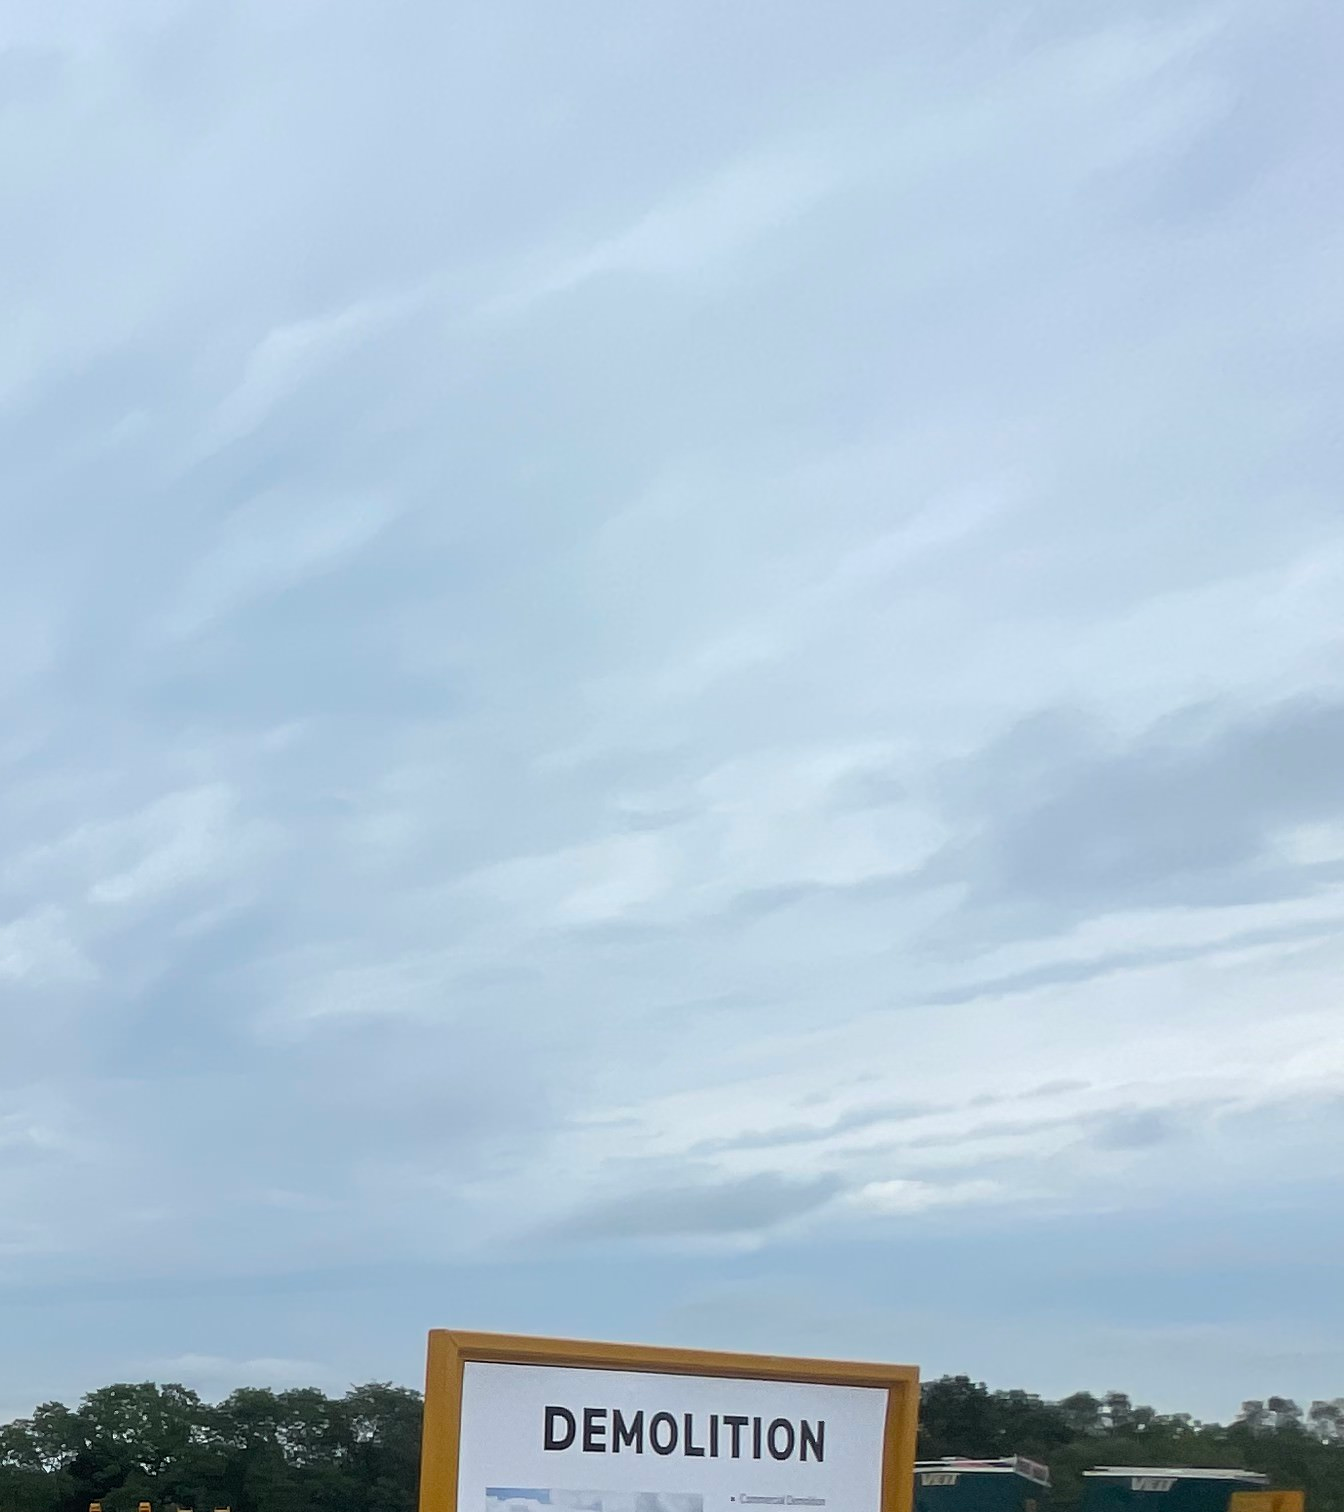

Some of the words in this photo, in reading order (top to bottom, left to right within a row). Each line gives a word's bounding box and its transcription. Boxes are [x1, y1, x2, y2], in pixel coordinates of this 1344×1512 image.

[543, 1405, 826, 1463] DEMOLITION
[921, 1472, 960, 1486] VEIT
[1131, 1477, 1178, 1492] VEIT
